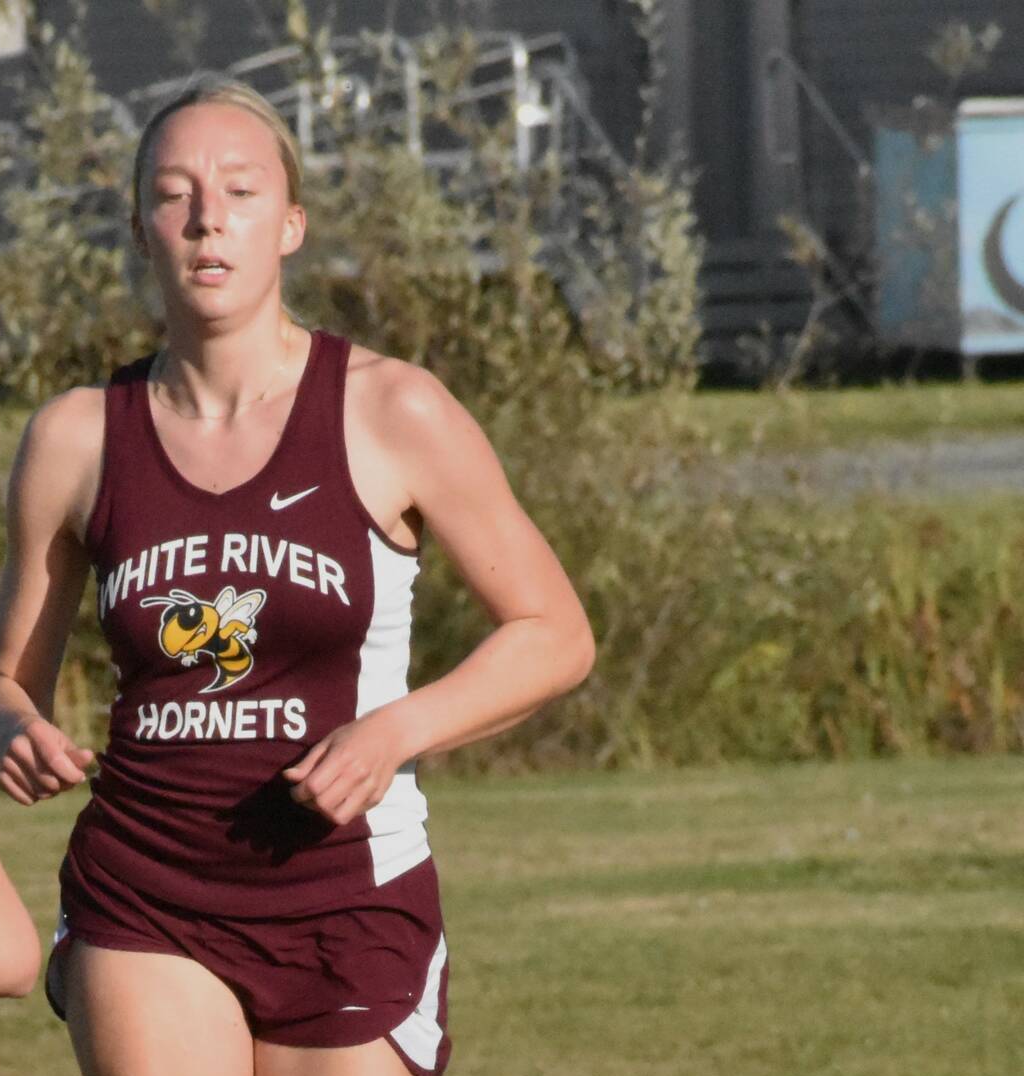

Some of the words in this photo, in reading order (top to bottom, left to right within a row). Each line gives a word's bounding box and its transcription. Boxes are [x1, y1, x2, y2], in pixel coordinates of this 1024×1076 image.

[100, 535, 209, 620] WHITE
[220, 533, 351, 606] RIVER
[136, 698, 307, 740] HORNETS
